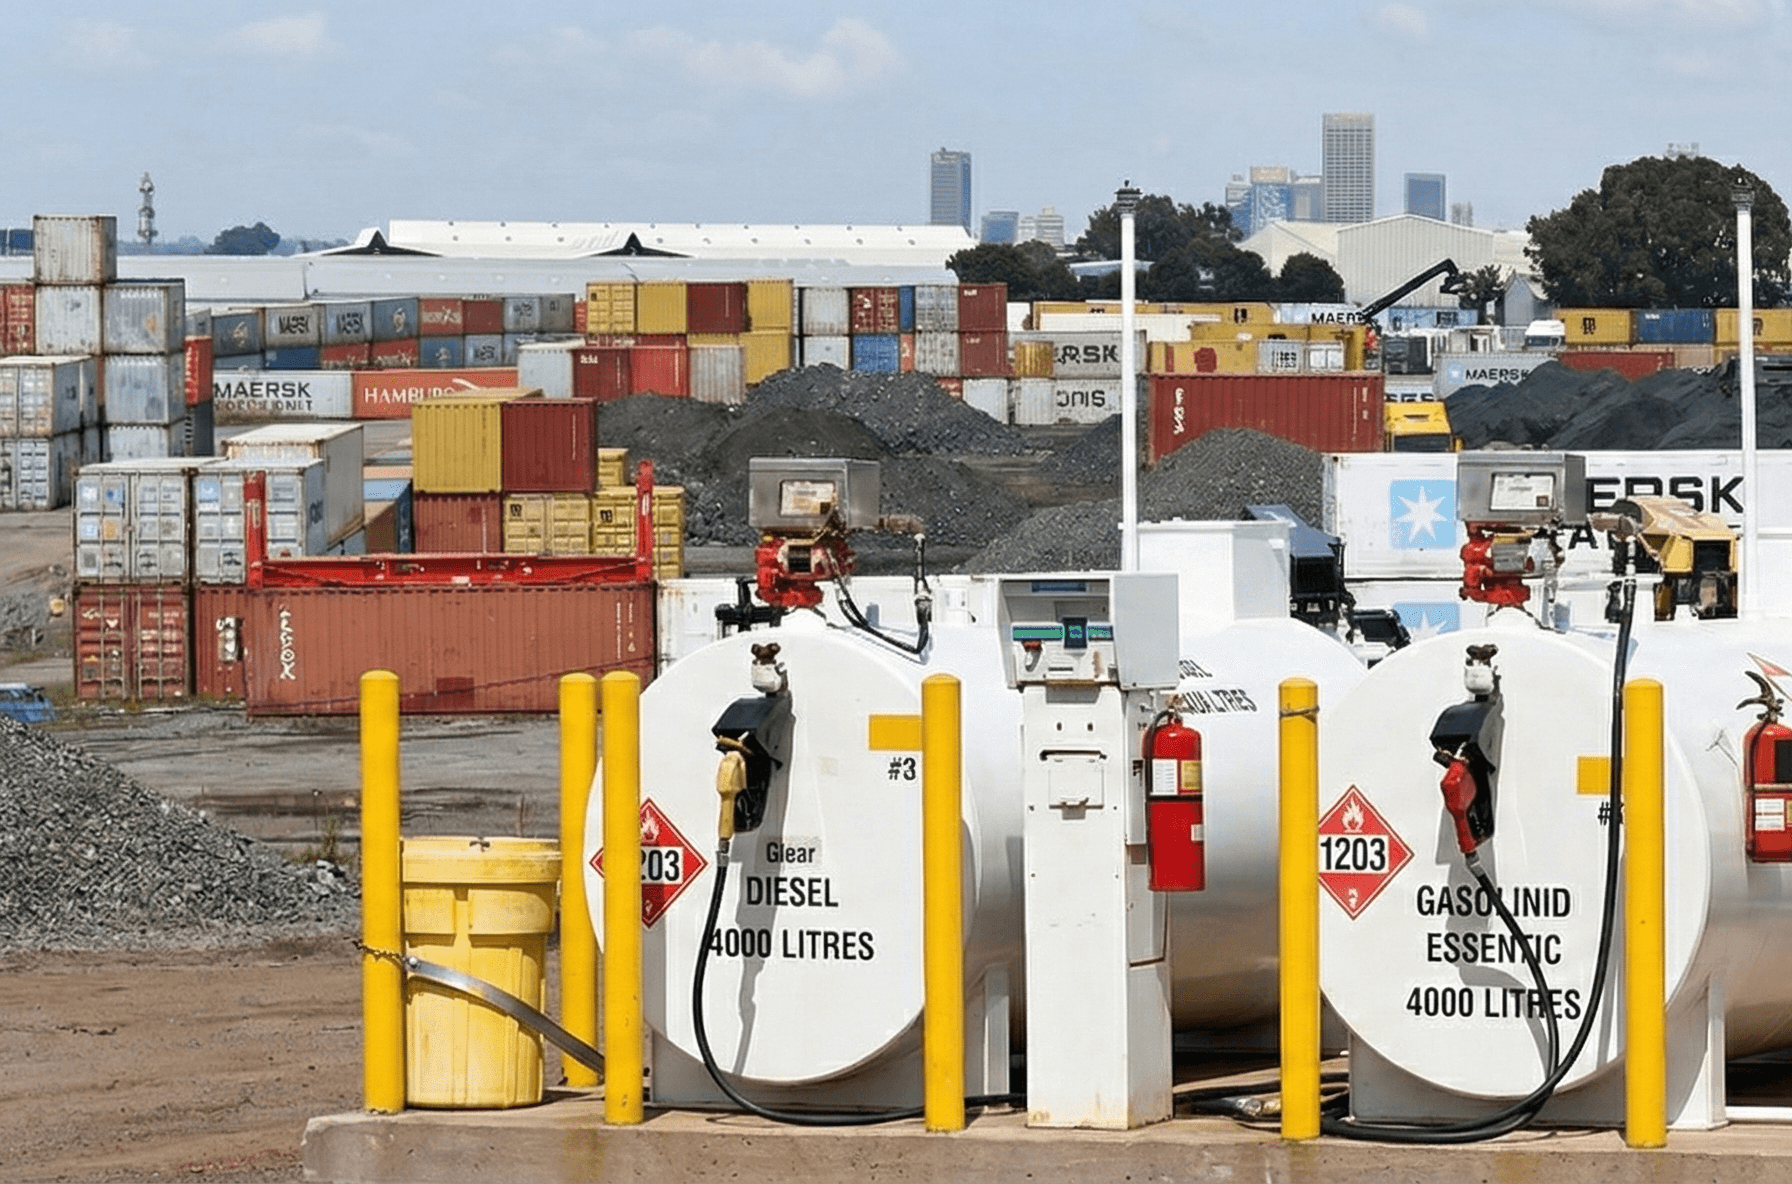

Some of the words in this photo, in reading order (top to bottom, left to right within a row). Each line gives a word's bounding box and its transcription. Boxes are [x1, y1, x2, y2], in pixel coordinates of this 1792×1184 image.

[214, 382, 312, 398] MAERSK
[887, 757, 916, 781] #3
[1320, 837, 1386, 871] 1203
[746, 877, 839, 907] DIESEL
[709, 929, 772, 958] 4000
[782, 929, 875, 961] LITRES
[1406, 987, 1473, 1017] 4000
[1485, 988, 1581, 1020] LITRES
